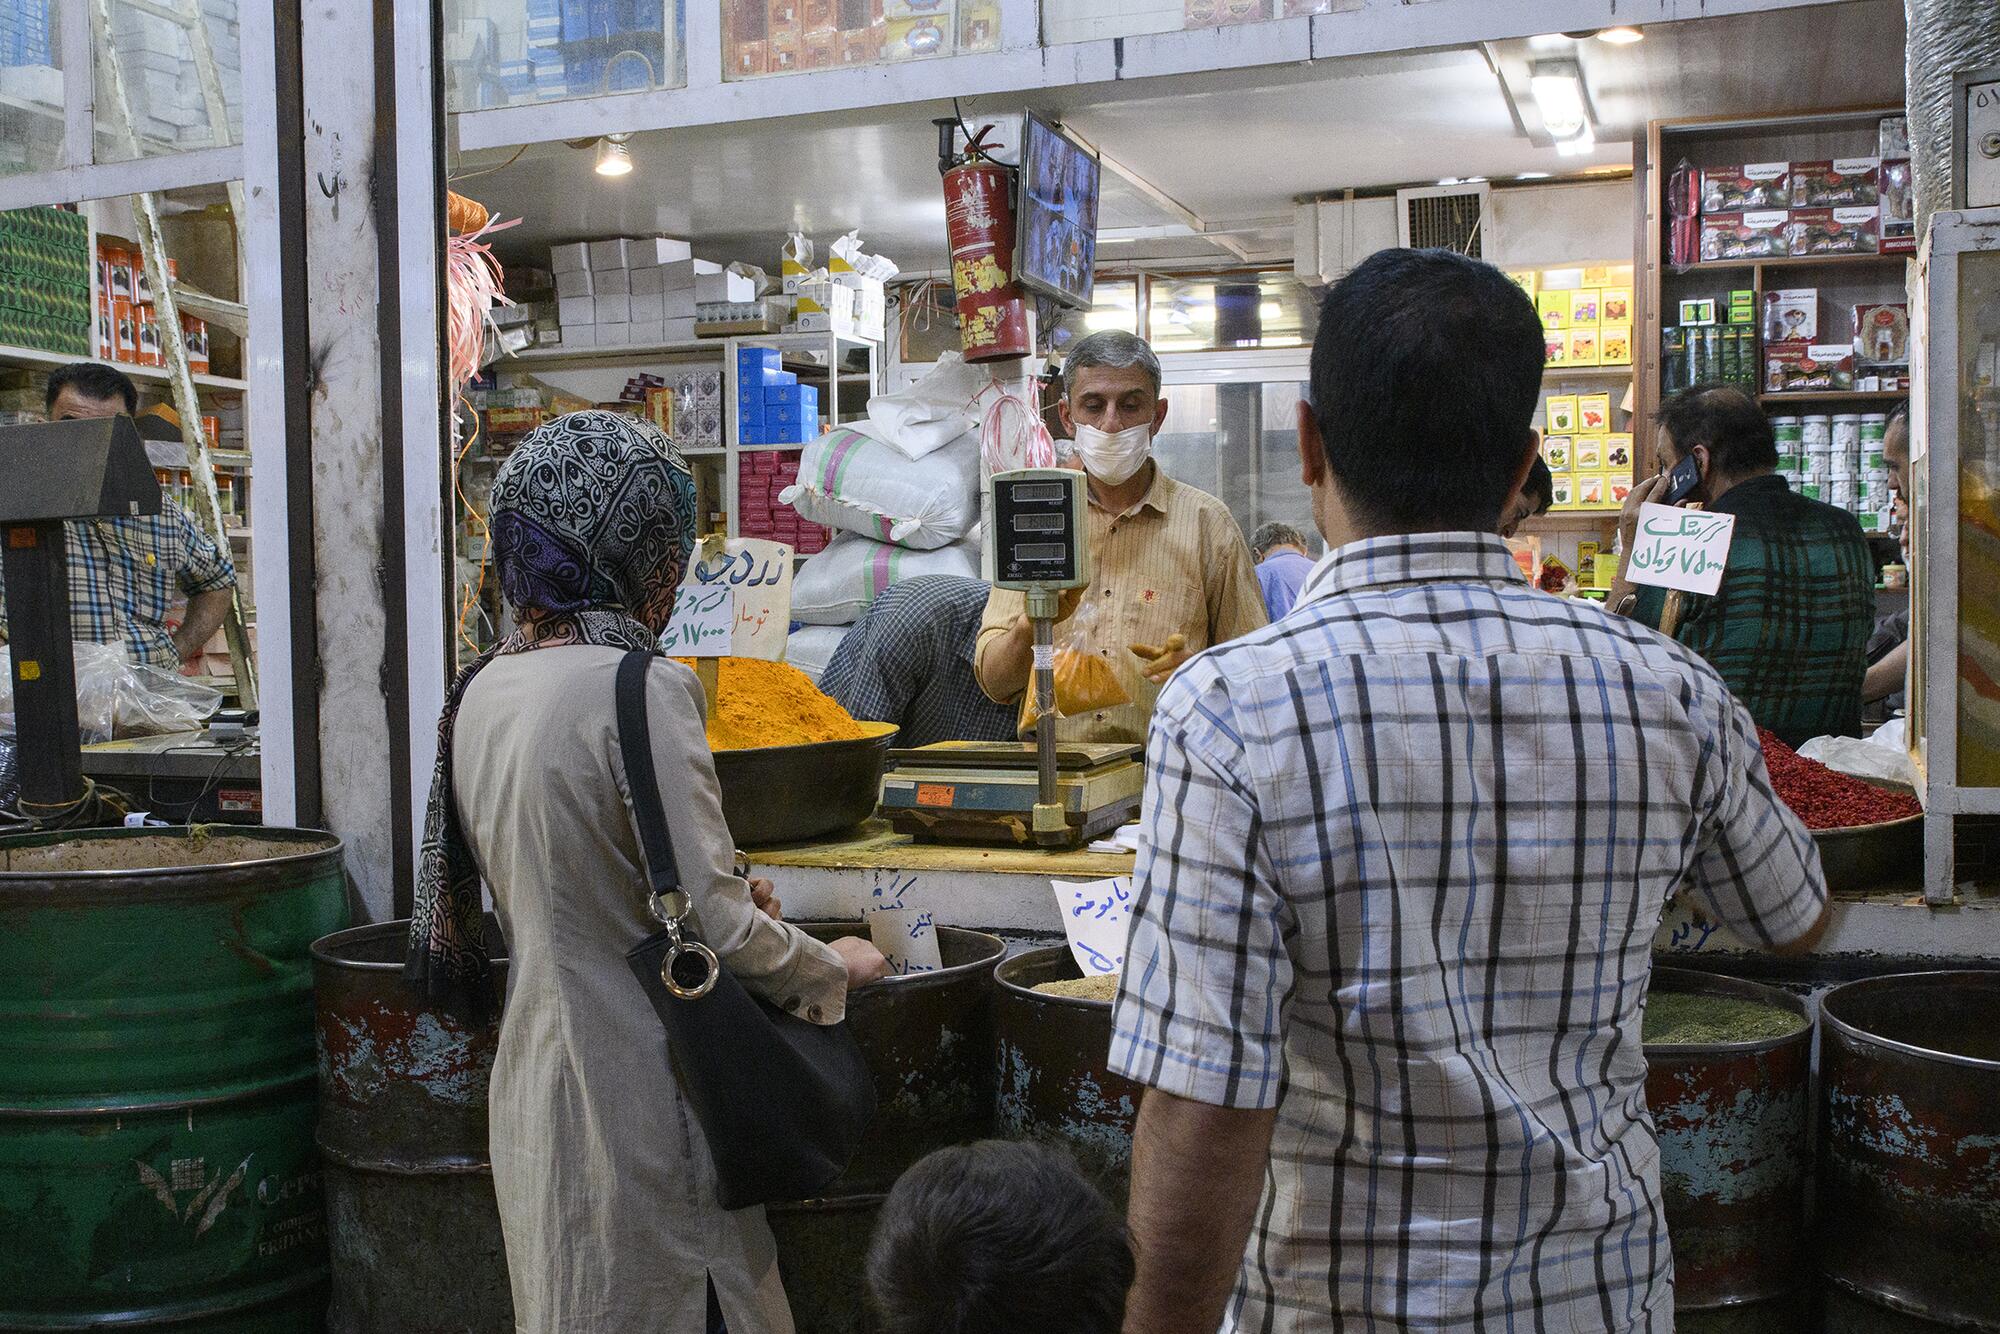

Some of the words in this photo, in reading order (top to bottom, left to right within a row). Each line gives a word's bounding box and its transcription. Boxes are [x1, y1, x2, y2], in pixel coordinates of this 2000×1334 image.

[1644, 514, 1731, 543] زرشک
[1632, 537, 1677, 574] تومان
[682, 621, 726, 646] ۱۷۰۰۰
